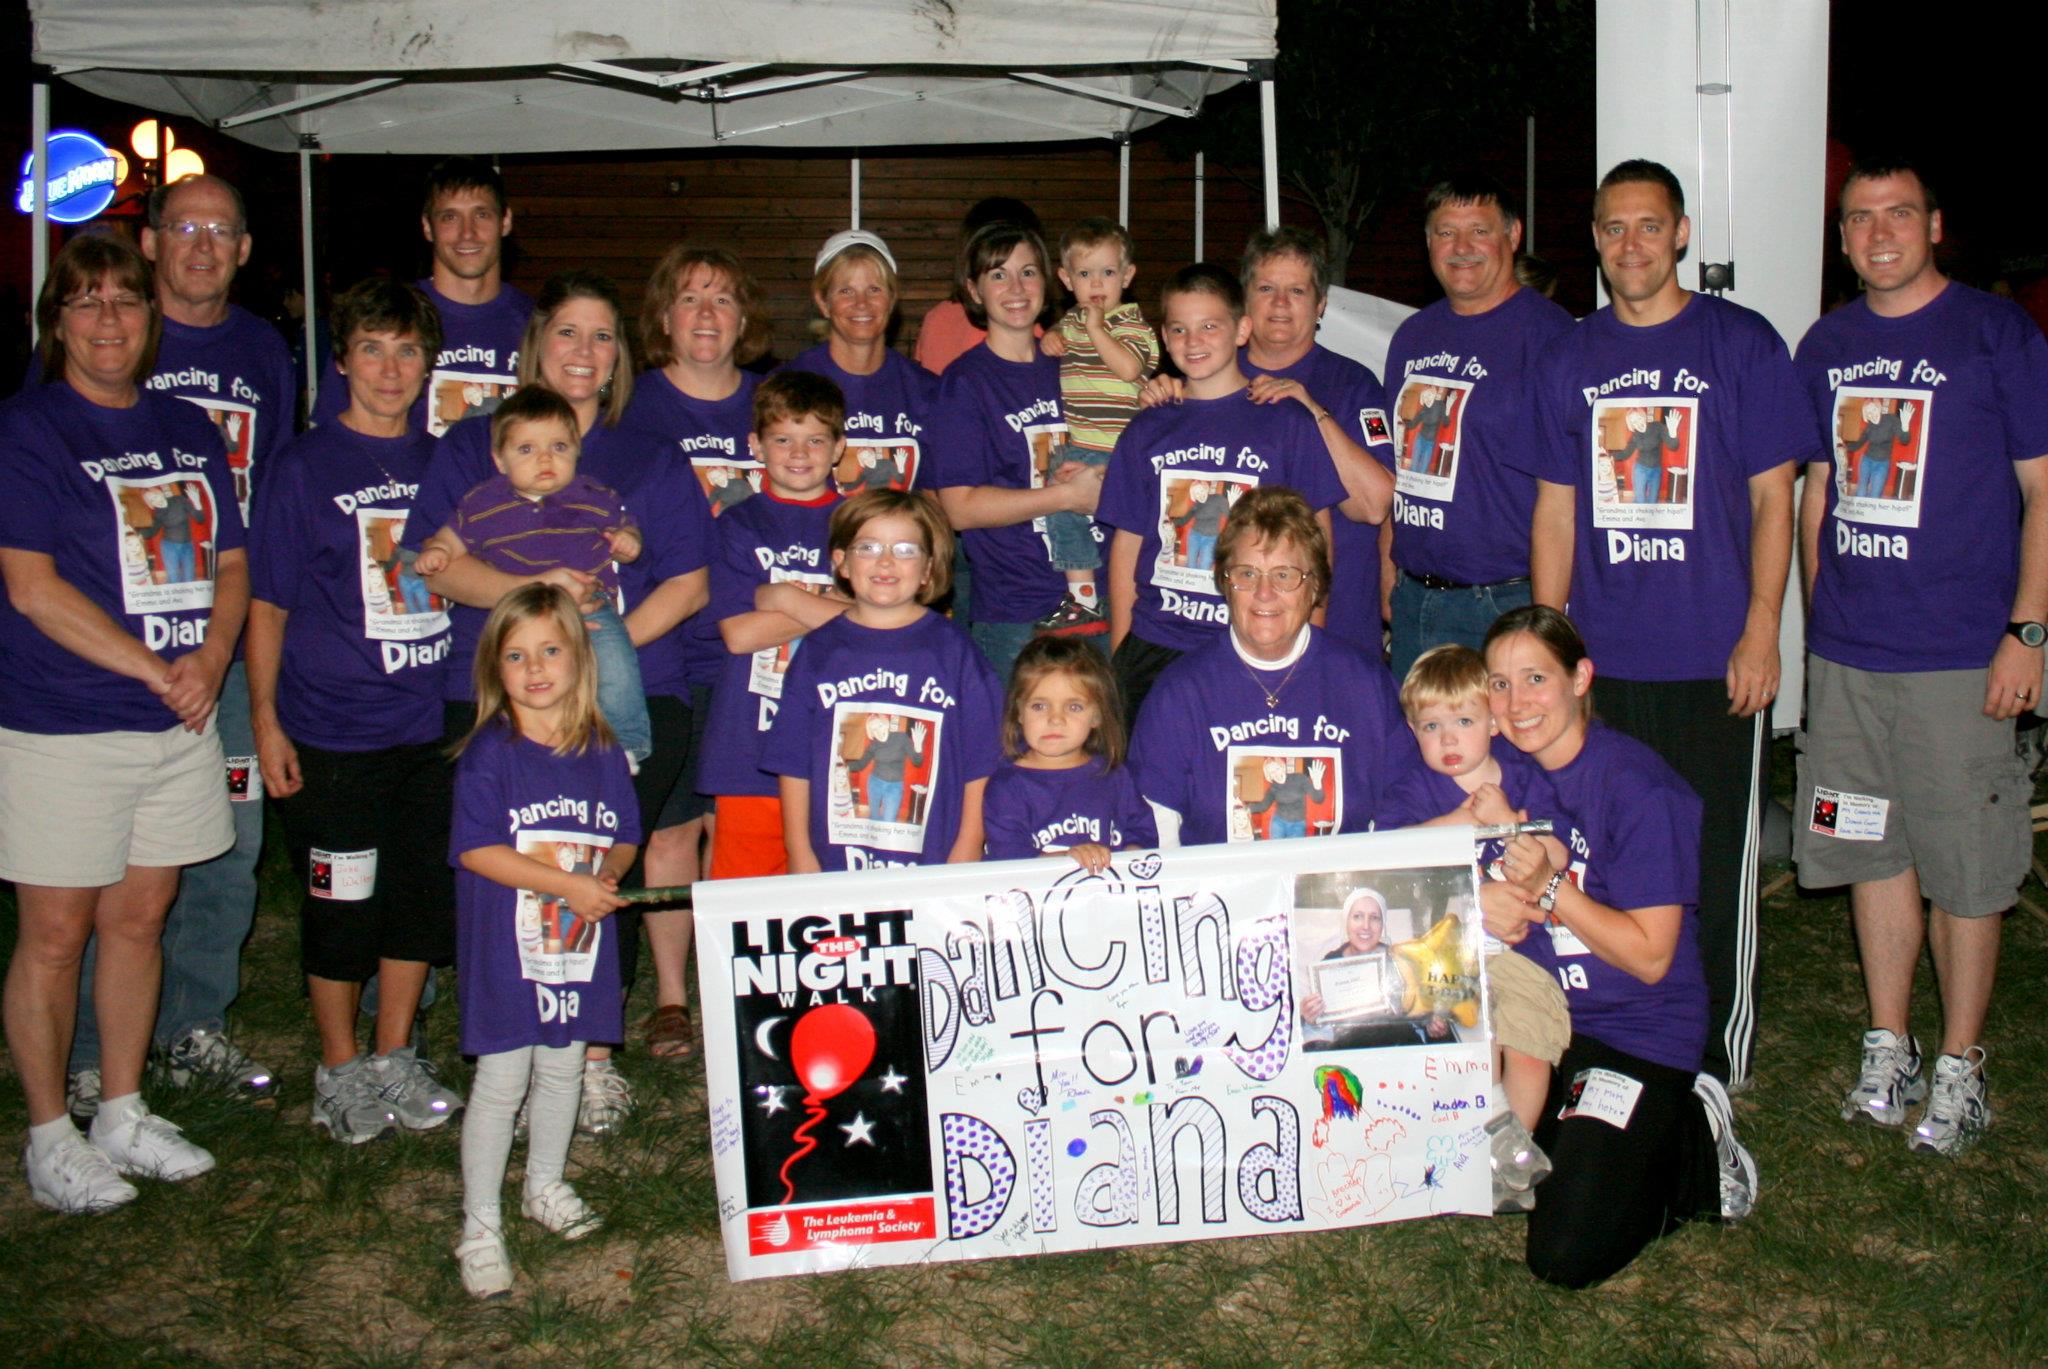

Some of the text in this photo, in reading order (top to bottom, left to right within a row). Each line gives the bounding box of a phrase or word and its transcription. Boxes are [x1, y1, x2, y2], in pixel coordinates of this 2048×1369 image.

[1403, 351, 1488, 380] Dancing for
[1827, 356, 1947, 391] Dancing for
[231, 377, 261, 404] for
[1582, 368, 1709, 407] Dancing for
[895, 412, 922, 437] for
[1004, 398, 1059, 432] Dancing
[680, 433, 735, 454] ncing
[1151, 444, 1268, 475] Dancing for
[80, 448, 208, 482] Dancing for
[1393, 491, 1444, 530] Diana
[1607, 529, 1685, 564] Diana
[1836, 520, 1908, 560] Diana
[1160, 588, 1230, 624] Diana
[143, 614, 210, 652] Dian
[817, 668, 909, 709] Dancing
[919, 677, 956, 709] for
[1209, 713, 1350, 752] Dancing for
[1031, 812, 1100, 849] ancing
[732, 909, 914, 956] LIGHT
[816, 941, 856, 954] THE
[733, 944, 917, 996] NIGHT
[778, 986, 877, 1008] WALK
[1010, 990, 1180, 1106] for
[1425, 1055, 1489, 1080] Emma
[940, 1095, 1304, 1240] Diana
[802, 1209, 896, 1228] The Leukemia &
[807, 1221, 921, 1241] Lymphoma Society
